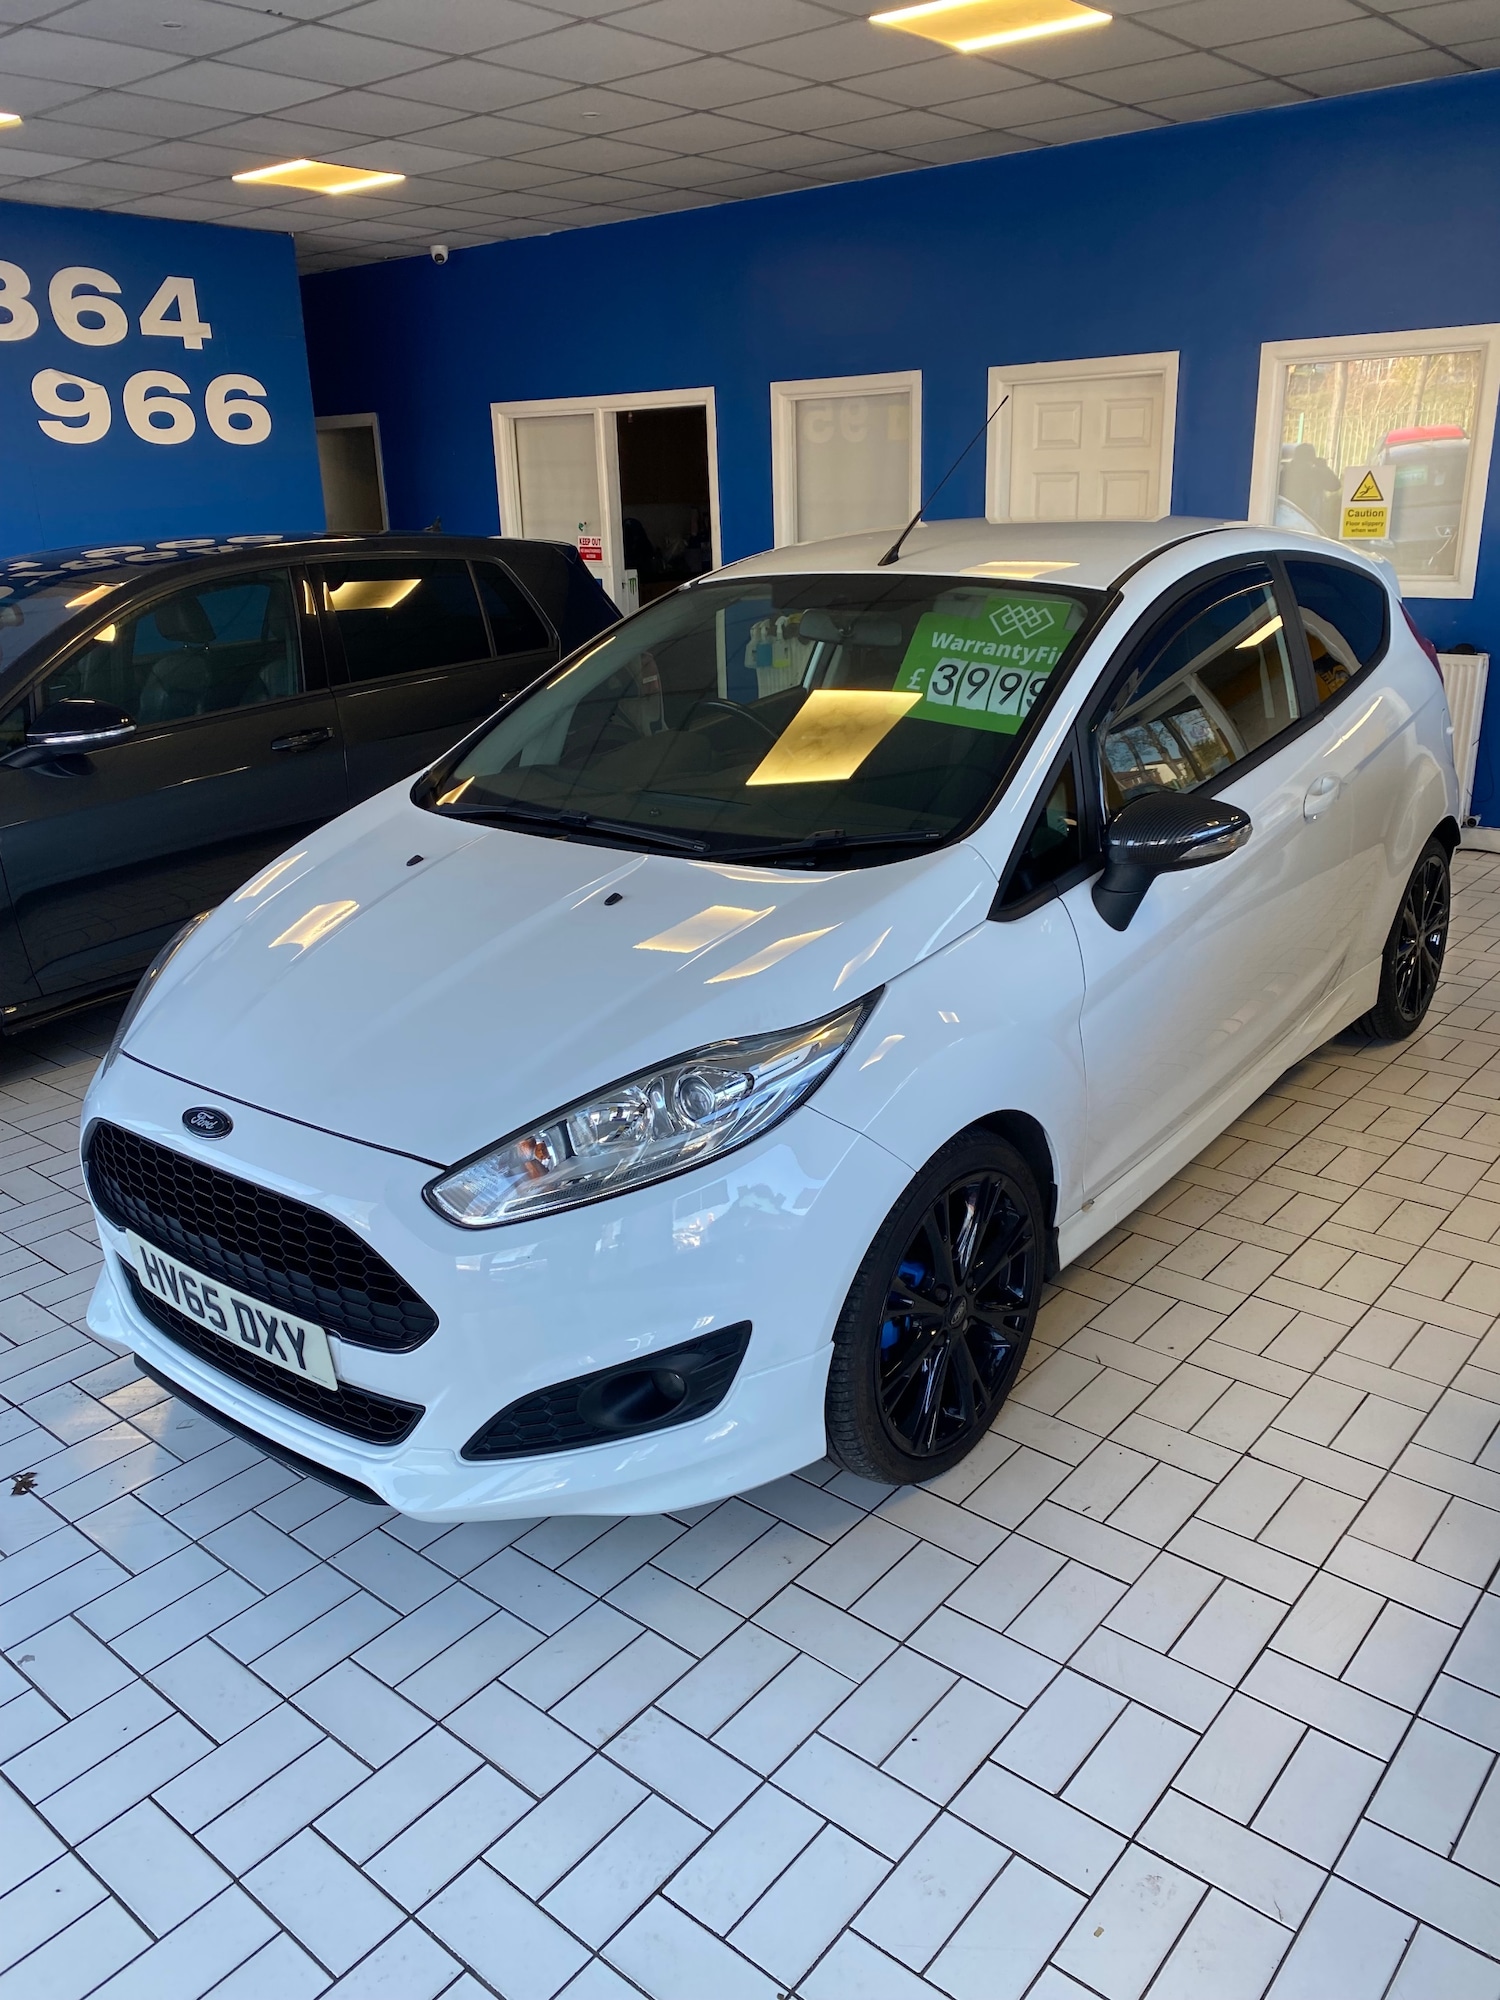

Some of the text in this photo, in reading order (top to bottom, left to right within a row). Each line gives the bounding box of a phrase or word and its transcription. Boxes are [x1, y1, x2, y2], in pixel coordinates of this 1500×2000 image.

[31, 367, 272, 445] 966
[1347, 509, 1384, 518] Caution
[579, 538, 601, 546] KEEP OUT
[190, 1111, 219, 1130] Ford
[139, 1245, 307, 1371] HV65 DXY
